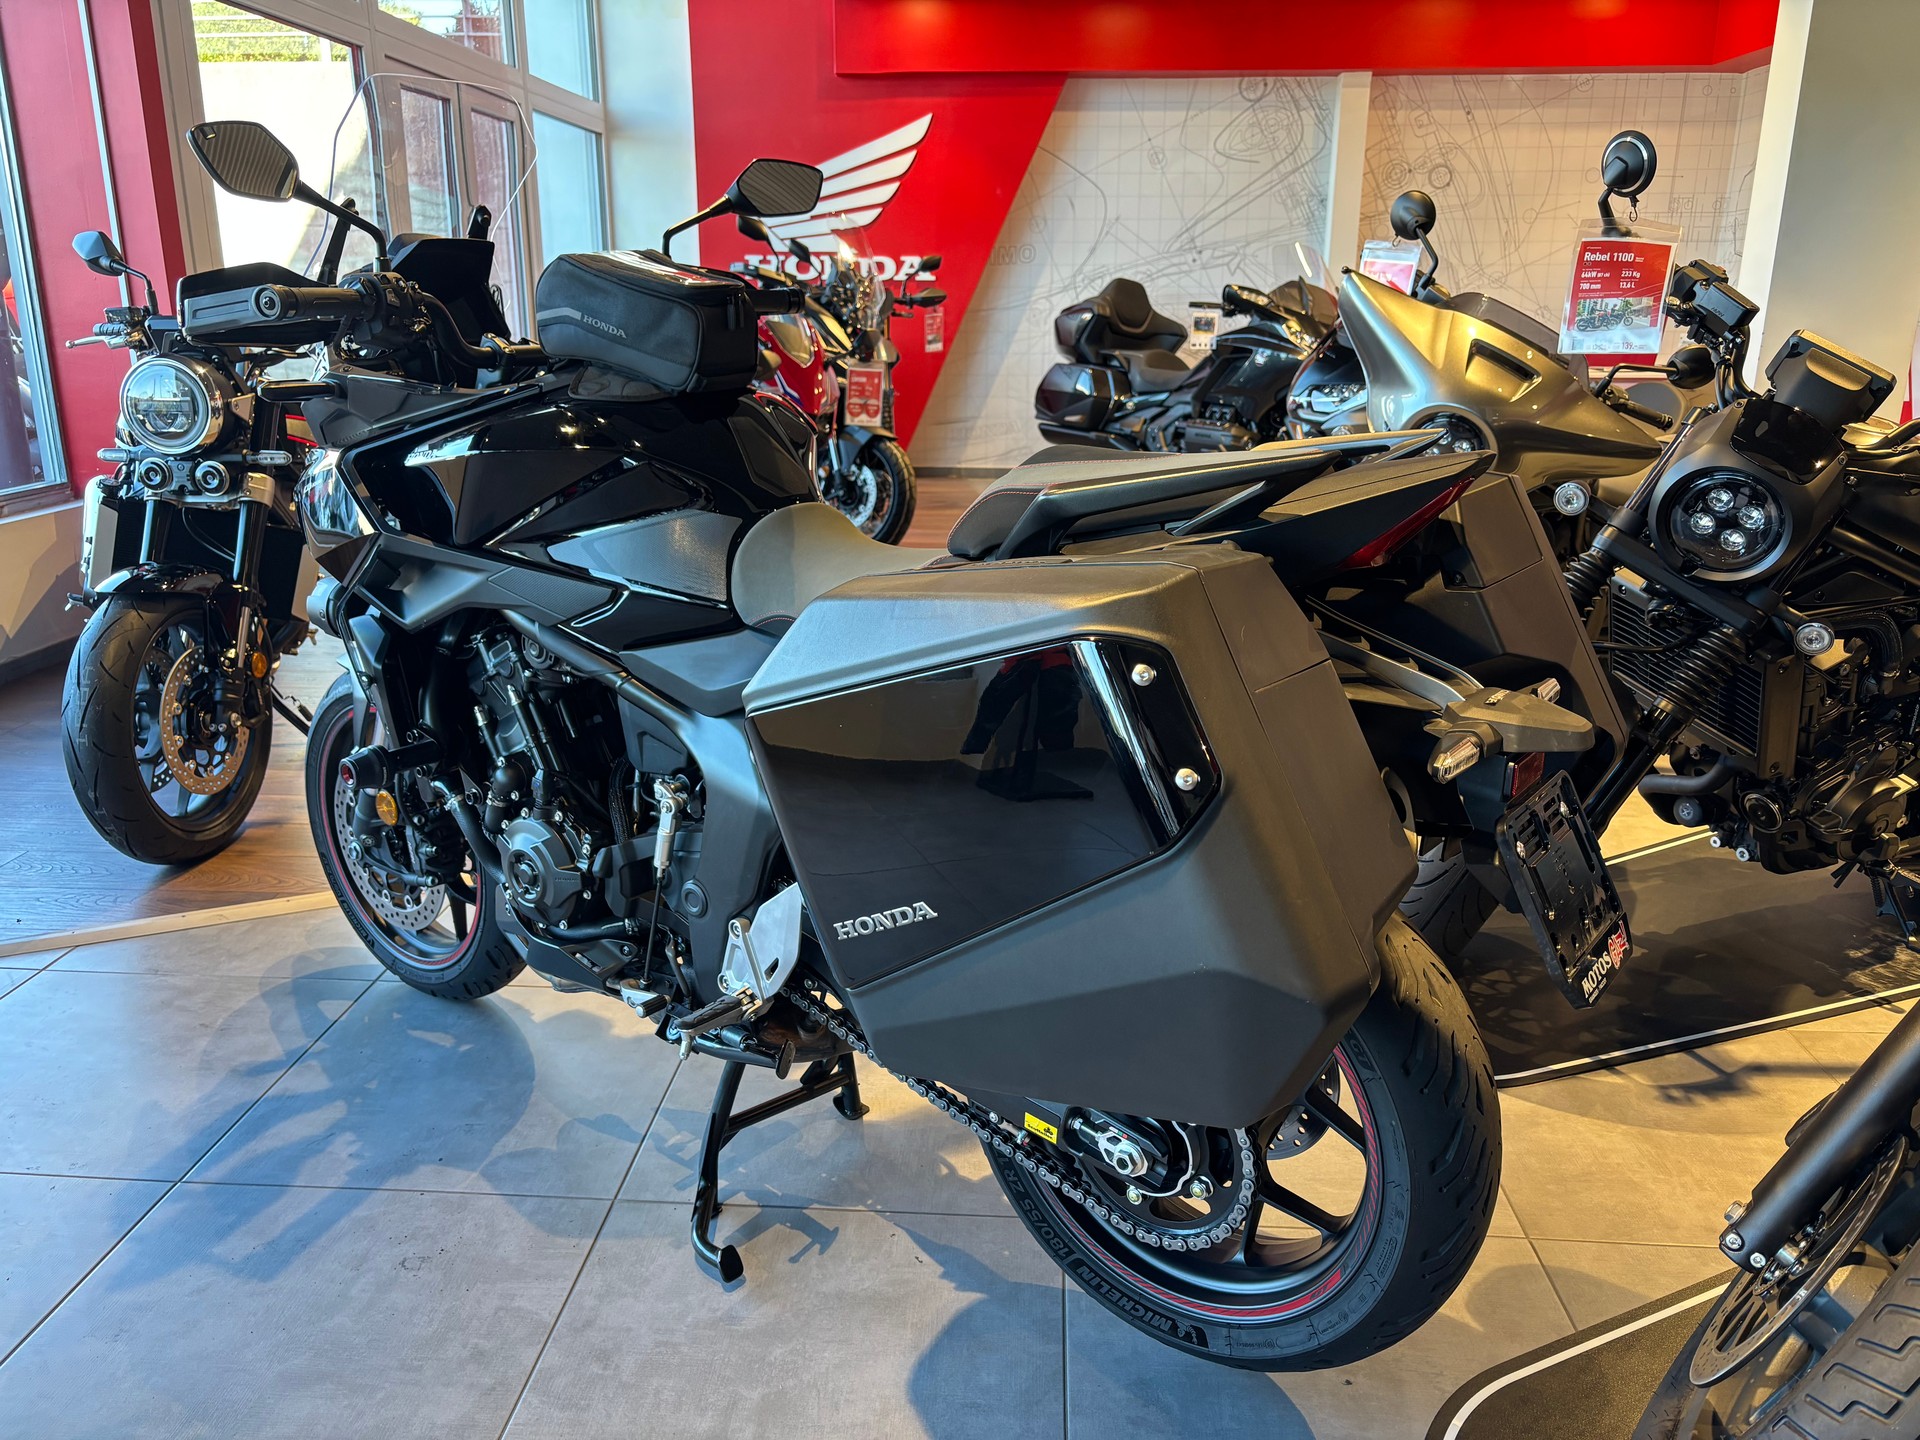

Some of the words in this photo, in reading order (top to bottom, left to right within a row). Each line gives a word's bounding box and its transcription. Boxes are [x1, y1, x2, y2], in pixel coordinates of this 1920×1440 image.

[1584, 252, 1610, 261] Rebel
[1613, 252, 1634, 262] 1100
[583, 314, 627, 339] HONDA
[833, 901, 939, 941] HONDA
[1581, 950, 1612, 999] MOTOS
[1004, 1169, 1026, 1193] ZR
[1021, 1200, 1069, 1260] 180/55
[1076, 1265, 1173, 1331] MICHELIN
